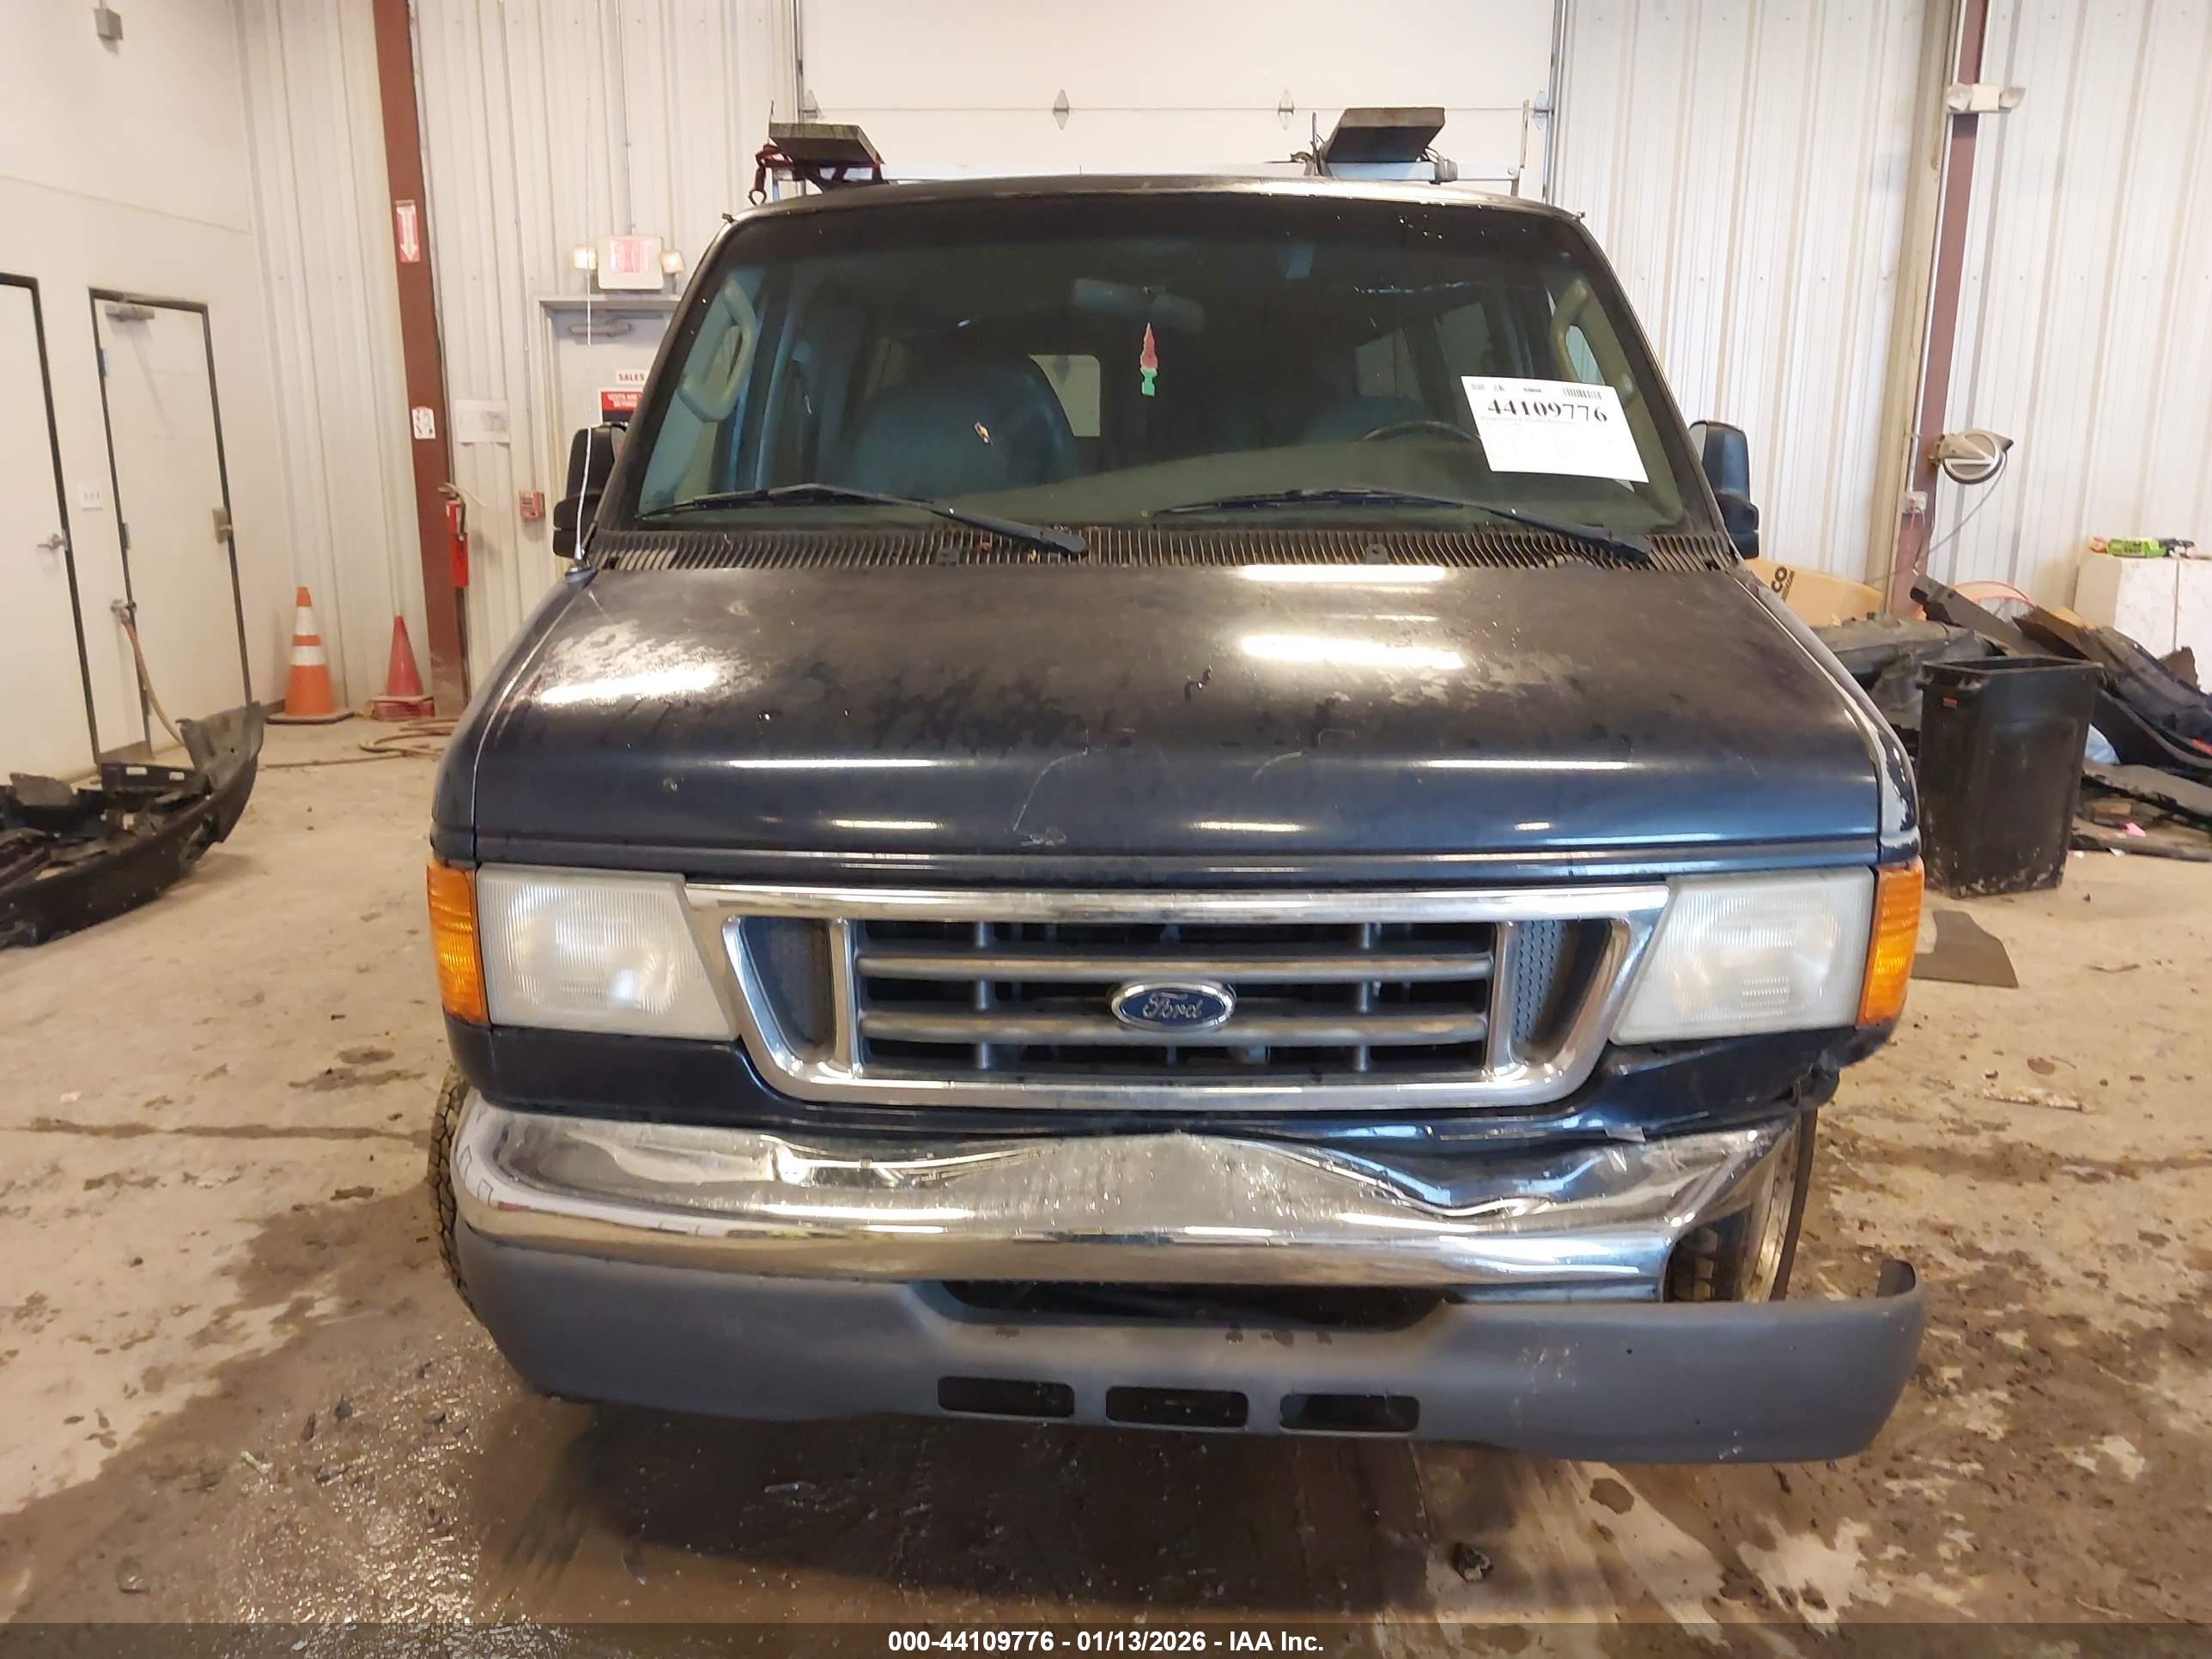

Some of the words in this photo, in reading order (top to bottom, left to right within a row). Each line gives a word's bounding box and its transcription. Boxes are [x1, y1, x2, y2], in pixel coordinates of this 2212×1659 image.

[610, 240, 652, 272] EXIT
[618, 373, 645, 381] SALES
[1487, 398, 1607, 422] 44109776
[1142, 991, 1203, 1018] Ford
